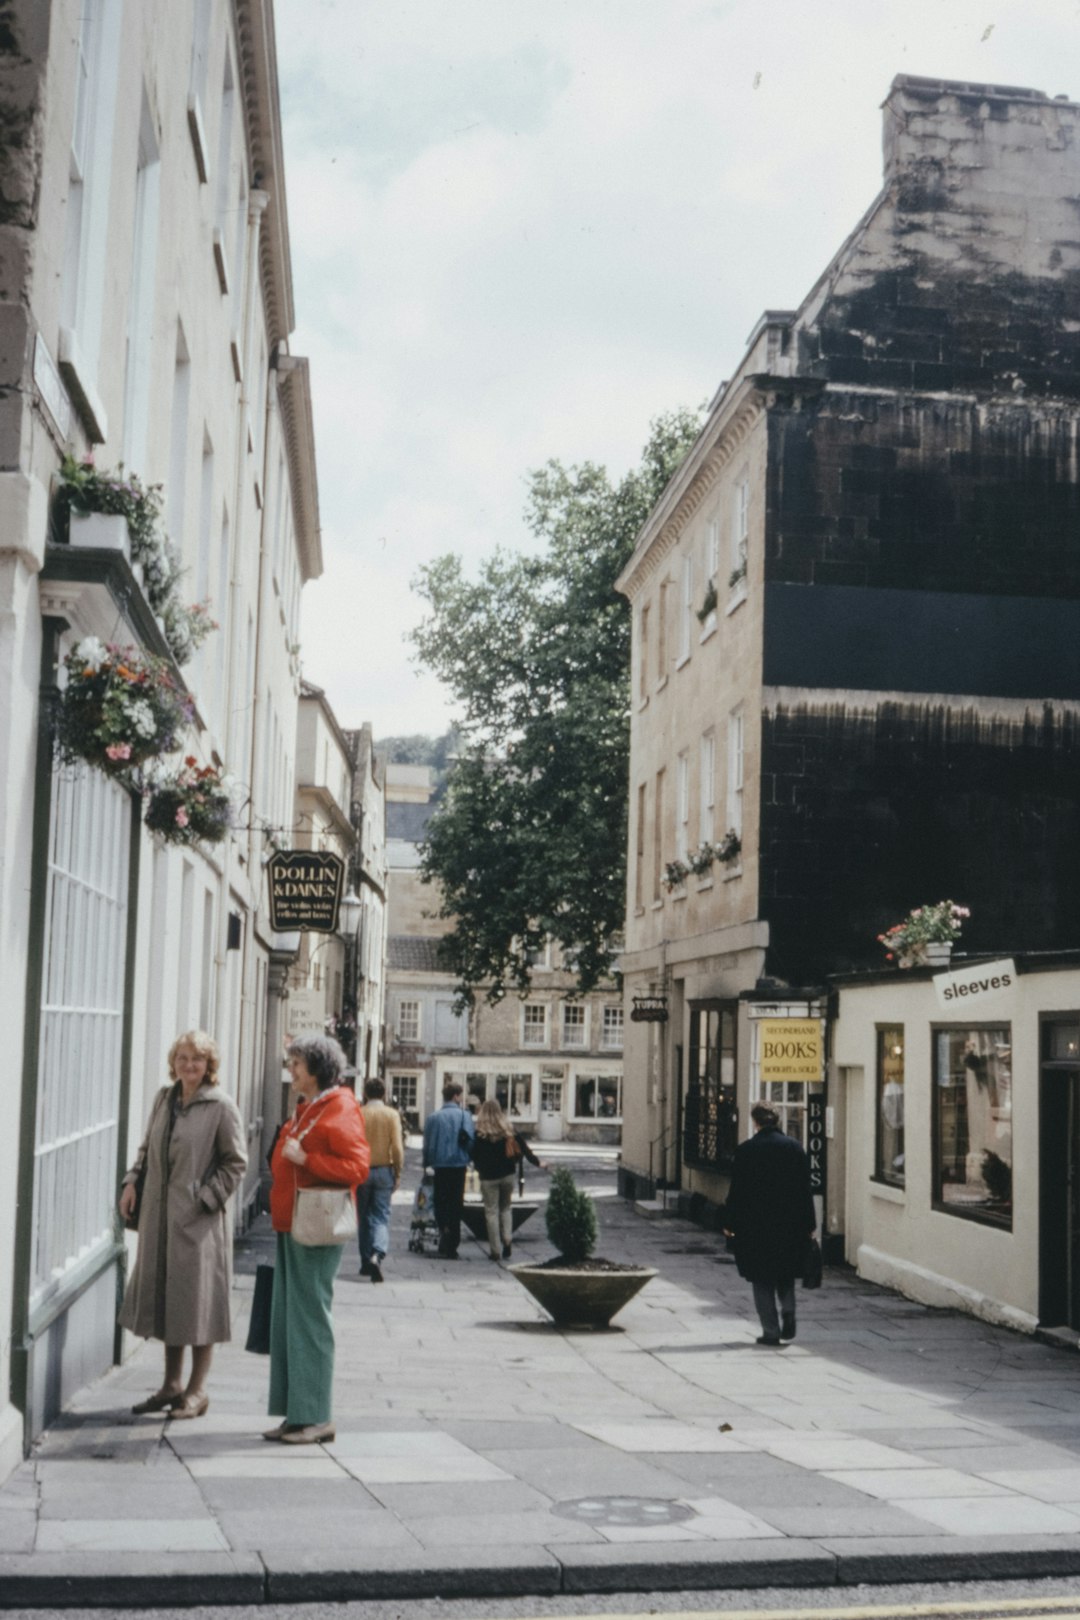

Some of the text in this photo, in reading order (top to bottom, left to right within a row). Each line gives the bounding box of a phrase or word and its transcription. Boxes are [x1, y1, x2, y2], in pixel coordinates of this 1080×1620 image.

[274, 866, 336, 881] DOLLIN
[299, 910, 311, 919] and
[943, 974, 1011, 1001] sleeves
[766, 1026, 816, 1035] SECONDHAND
[764, 1042, 817, 1059] BOOKS
[764, 1066, 792, 1074] BOUGHT
[799, 1066, 818, 1074] SOLD
[809, 1102, 823, 1187] BOOKS
